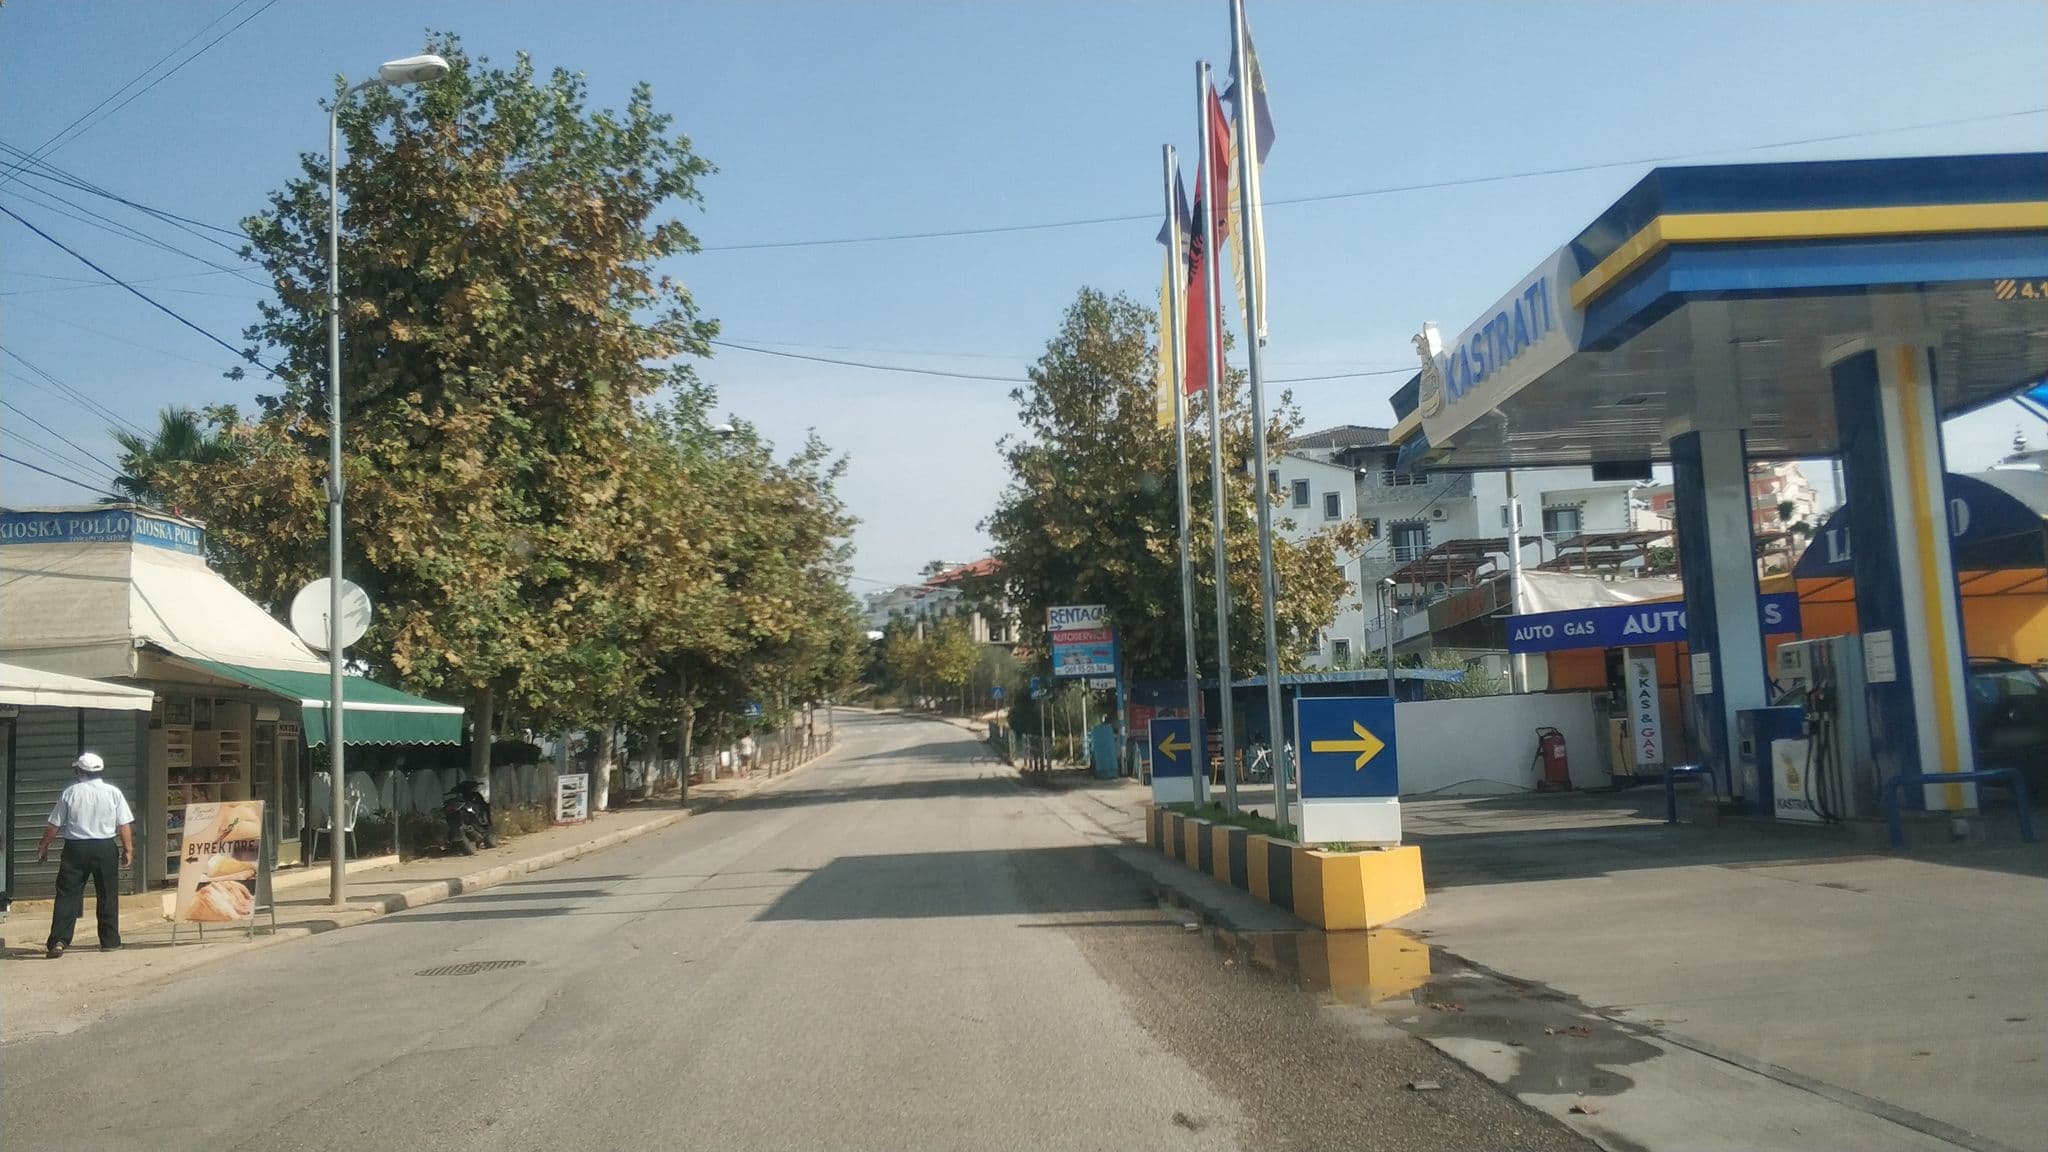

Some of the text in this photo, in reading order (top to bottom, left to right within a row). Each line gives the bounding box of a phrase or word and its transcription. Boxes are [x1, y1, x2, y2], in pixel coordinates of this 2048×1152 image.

[1445, 277, 1550, 405] KASTRATI
[0, 519, 62, 538] KIOSKA
[136, 518, 172, 540] KIOSKA
[1514, 620, 1595, 641] AUTO GAS
[1639, 679, 1655, 759] KAS & GAS
[188, 840, 255, 856] BYREKTORE
